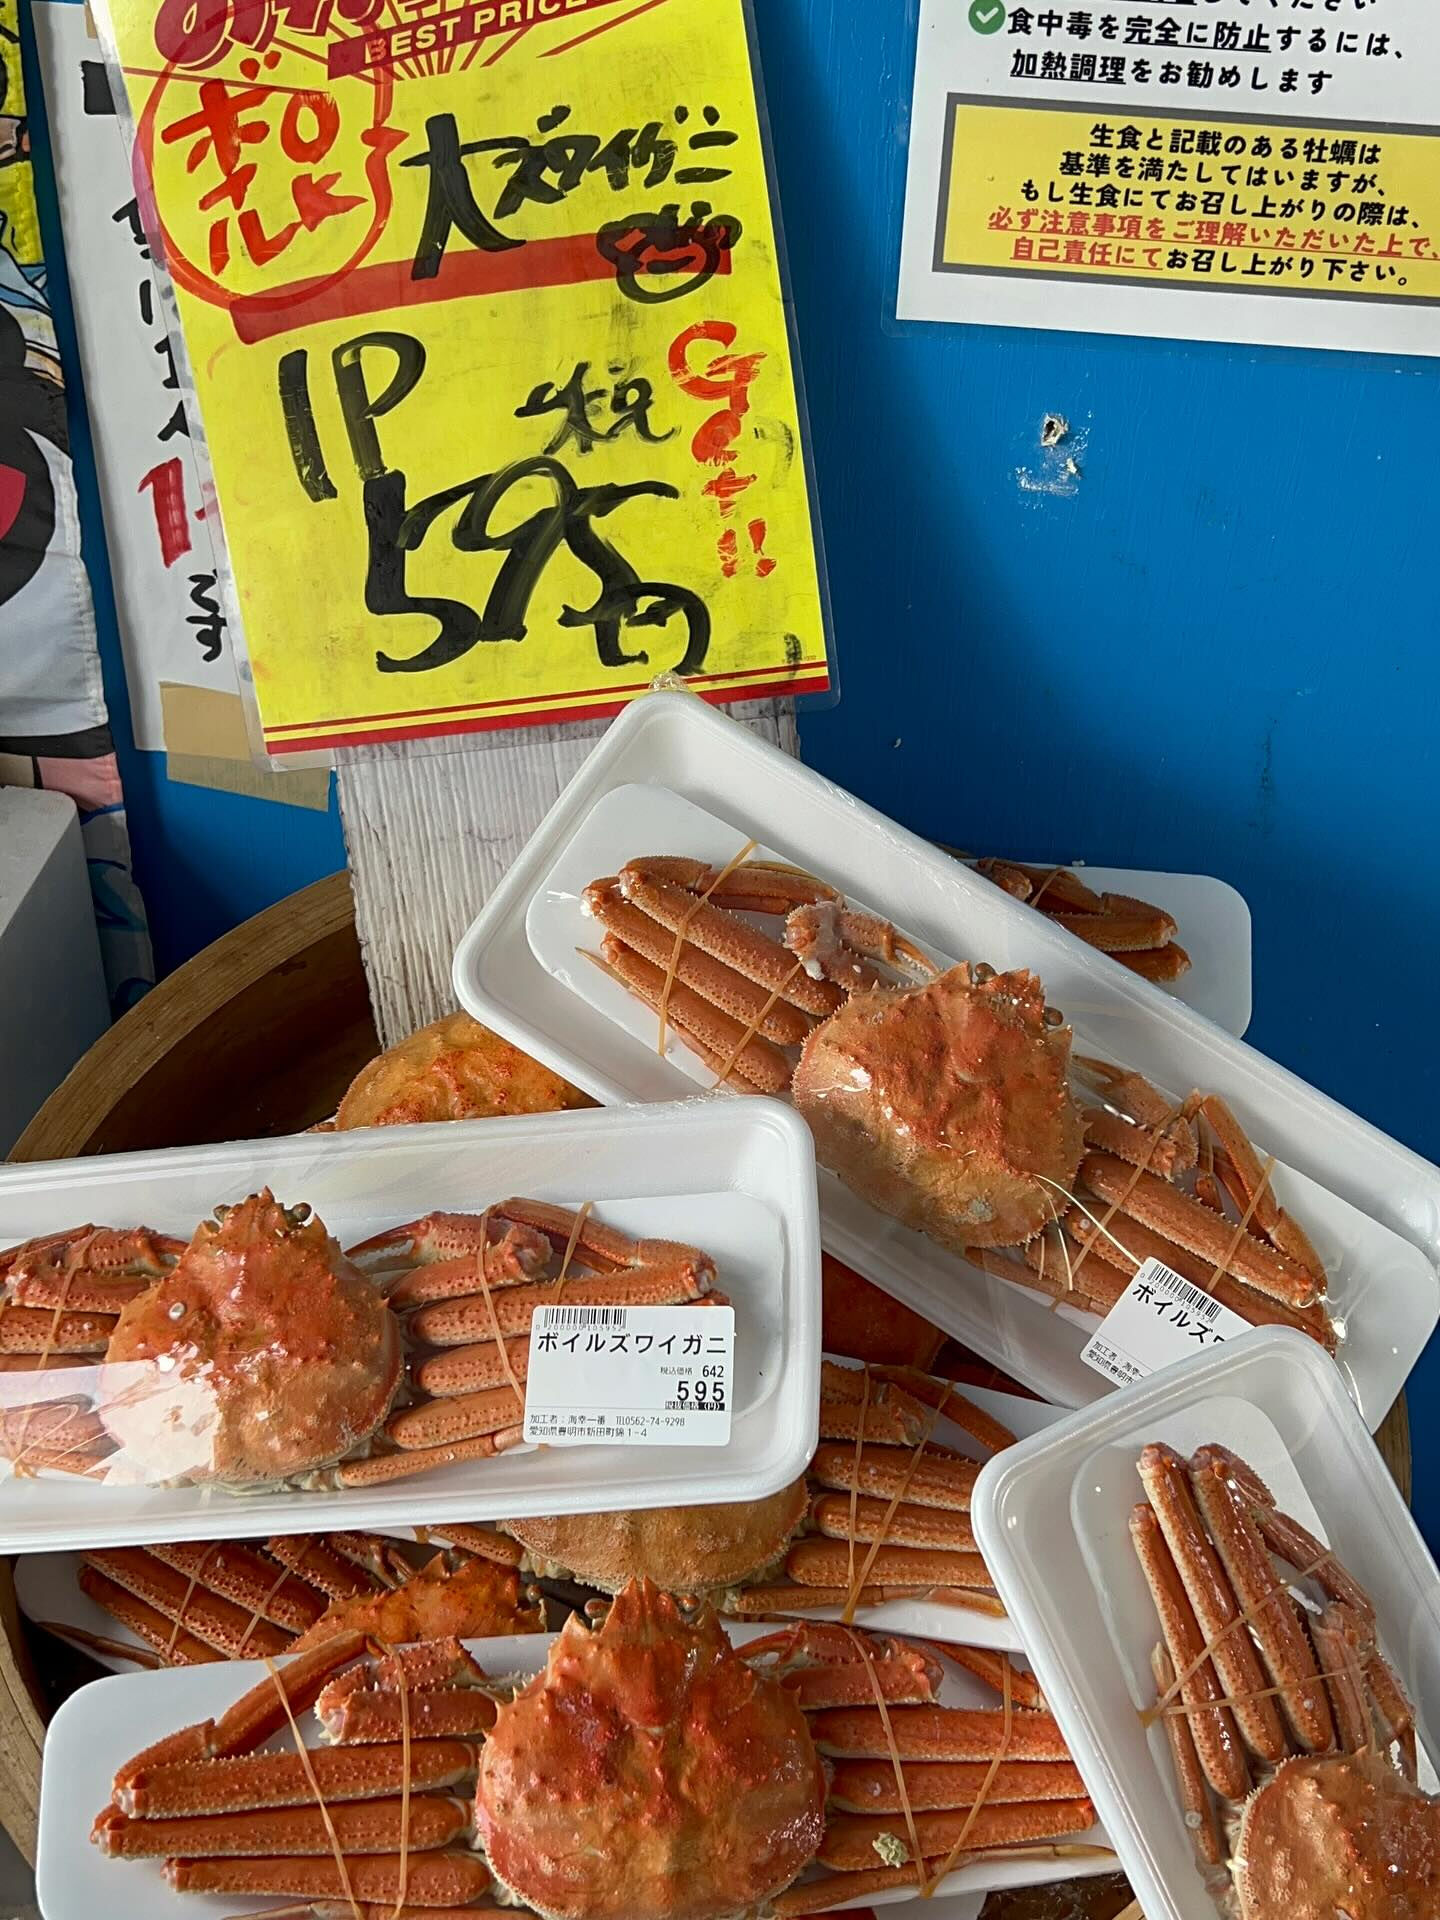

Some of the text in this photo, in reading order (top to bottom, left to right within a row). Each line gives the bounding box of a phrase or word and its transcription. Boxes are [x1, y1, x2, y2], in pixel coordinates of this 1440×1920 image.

[365, 17, 461, 64] BEST
[1007, 7, 1403, 59] 食中毒を完全に防止するには、
[1010, 48, 1333, 94] 加熱調理をお勧めします
[1090, 123, 1381, 166] 生食と記載のある牡蠣は
[1060, 152, 1385, 197] 基準を満たしてはいますが、
[1020, 180, 1419, 229] もし生食にてお召し上がりの際は、
[988, 206, 1439, 260] 必ず注意事項をご理解いただいた上で、
[1011, 236, 1408, 286] 自己責任にてお召し上がり下さい。
[538, 1333, 727, 1355] ボイルズワイガニ
[677, 1381, 725, 1402] 595
[702, 1365, 725, 1378] 642
